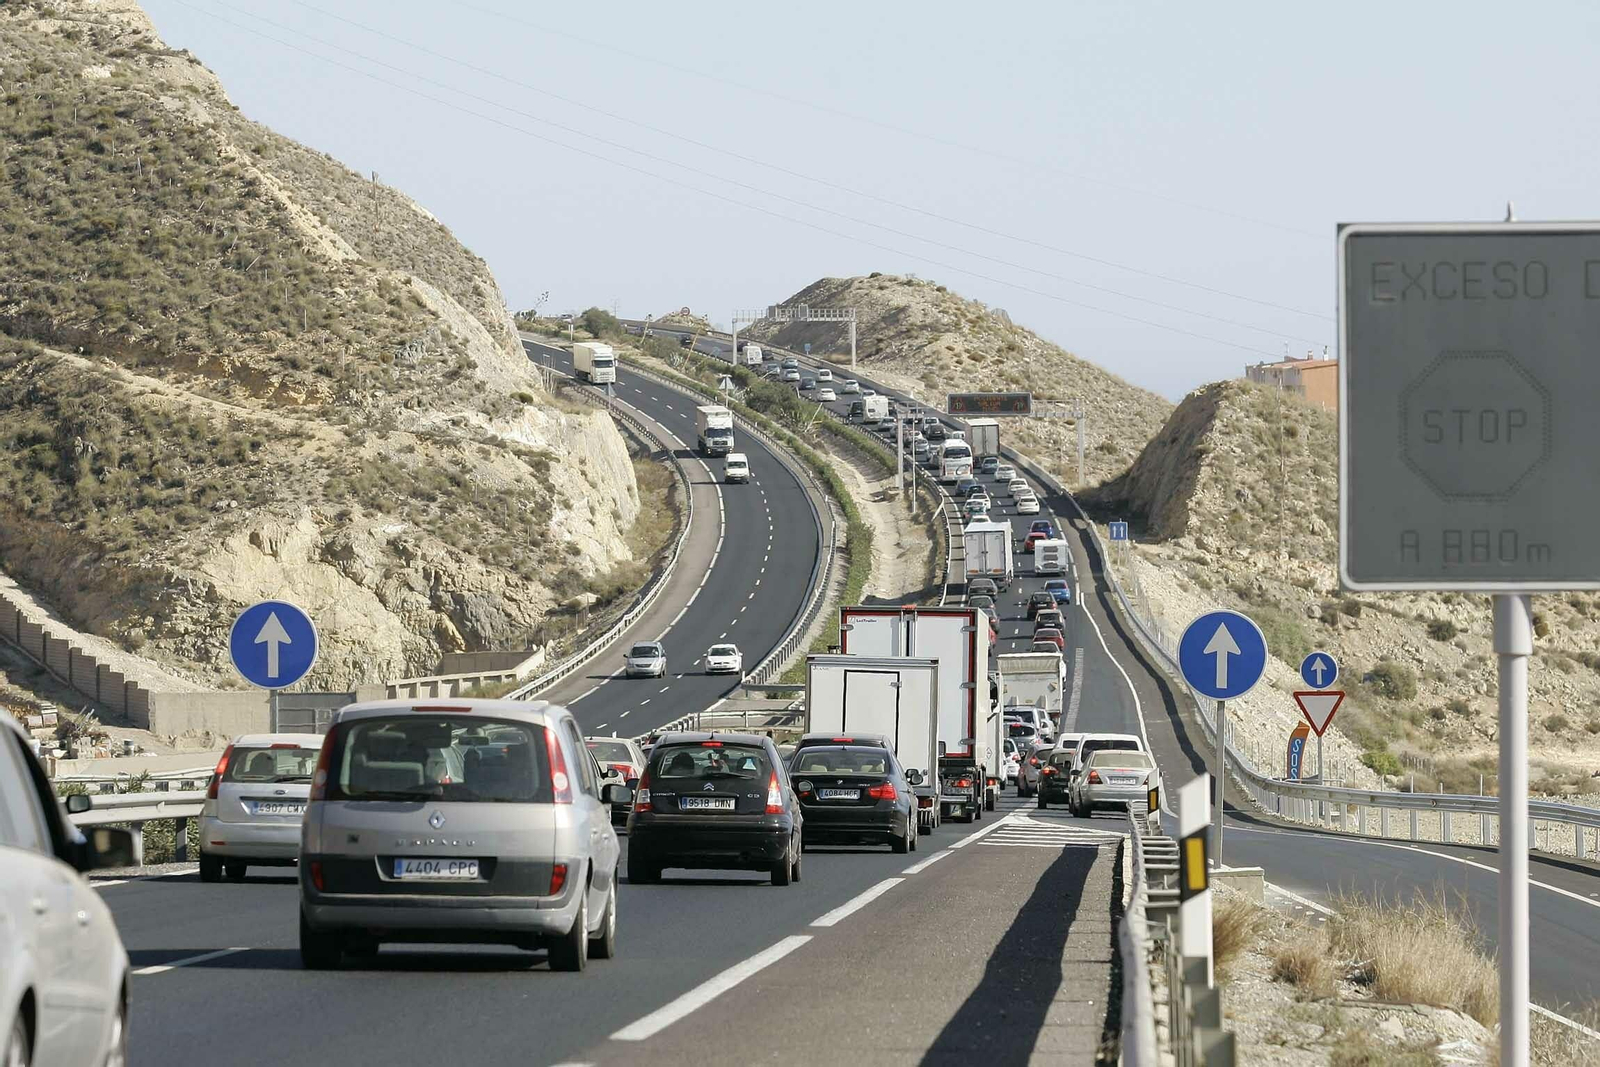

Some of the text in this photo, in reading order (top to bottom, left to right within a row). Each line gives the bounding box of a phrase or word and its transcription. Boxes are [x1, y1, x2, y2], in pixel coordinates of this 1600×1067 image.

[1371, 260, 1548, 302] EXCESO
[1422, 408, 1528, 444] STOP
[1400, 528, 1421, 565] A
[1291, 739, 1301, 780] SOS
[688, 798, 710, 808] 9518
[405, 861, 477, 876] 4404 CPC
